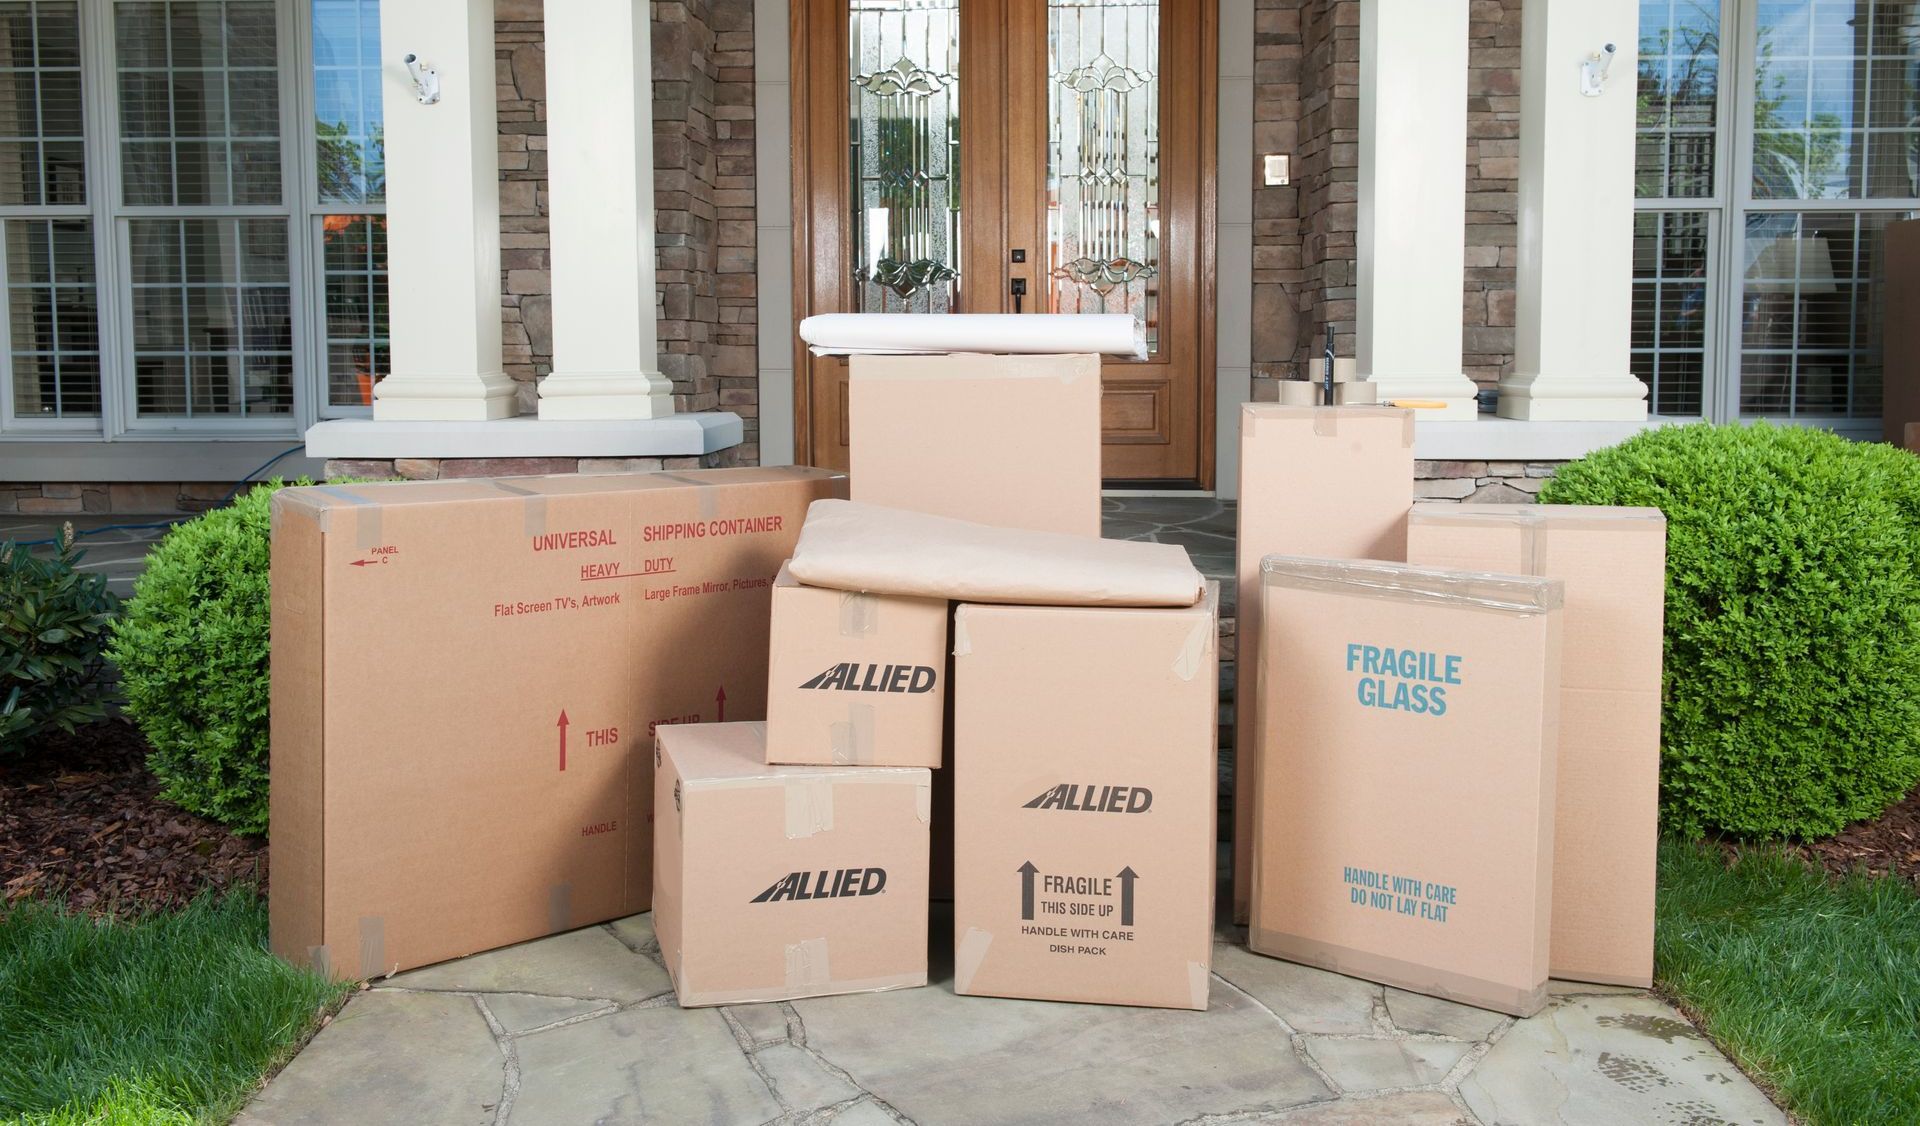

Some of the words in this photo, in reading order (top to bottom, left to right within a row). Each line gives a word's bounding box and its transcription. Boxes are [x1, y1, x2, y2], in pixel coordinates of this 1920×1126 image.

[533, 529, 617, 551] UNIVERSAL
[643, 521, 706, 542] SHIPPING
[709, 515, 783, 537] CONTAINER
[371, 545, 399, 555] PANEL
[381, 556, 388, 564] C
[581, 561, 621, 578] HEAVY
[644, 557, 674, 573] DUTY
[494, 603, 514, 617] Flat
[516, 600, 552, 615] Screen
[554, 597, 579, 610] TV's,
[581, 592, 620, 607] Artwork
[644, 588, 671, 602] Large
[672, 585, 700, 597] Frame
[702, 581, 731, 594] Mirror,
[733, 577, 769, 590] Pictures,
[1346, 643, 1462, 685] FRAGILE
[798, 662, 937, 694] ALLIED
[1357, 677, 1447, 716] GLASS
[586, 727, 619, 747] THIS
[1021, 783, 1153, 814] ALLIED
[581, 821, 617, 837] HANDLE
[749, 867, 887, 904] ALLIED
[1044, 875, 1112, 896] FRAGILE
[1343, 866, 1389, 891] HANDLE
[1392, 876, 1422, 898] WITH
[1426, 883, 1457, 905] CARE
[1040, 901, 1066, 915] THIS
[1069, 902, 1095, 916] SIDE
[1098, 905, 1114, 917] UP
[1351, 887, 1367, 906] DO
[1370, 891, 1394, 911] NOT
[1397, 896, 1418, 916] LAY
[1421, 901, 1449, 922] FLAT
[1021, 925, 1068, 937] HANDLE
[1070, 928, 1099, 939] WITH
[1102, 930, 1134, 941] CARE
[1049, 944, 1075, 954] DISH
[1078, 946, 1107, 955] PACK
